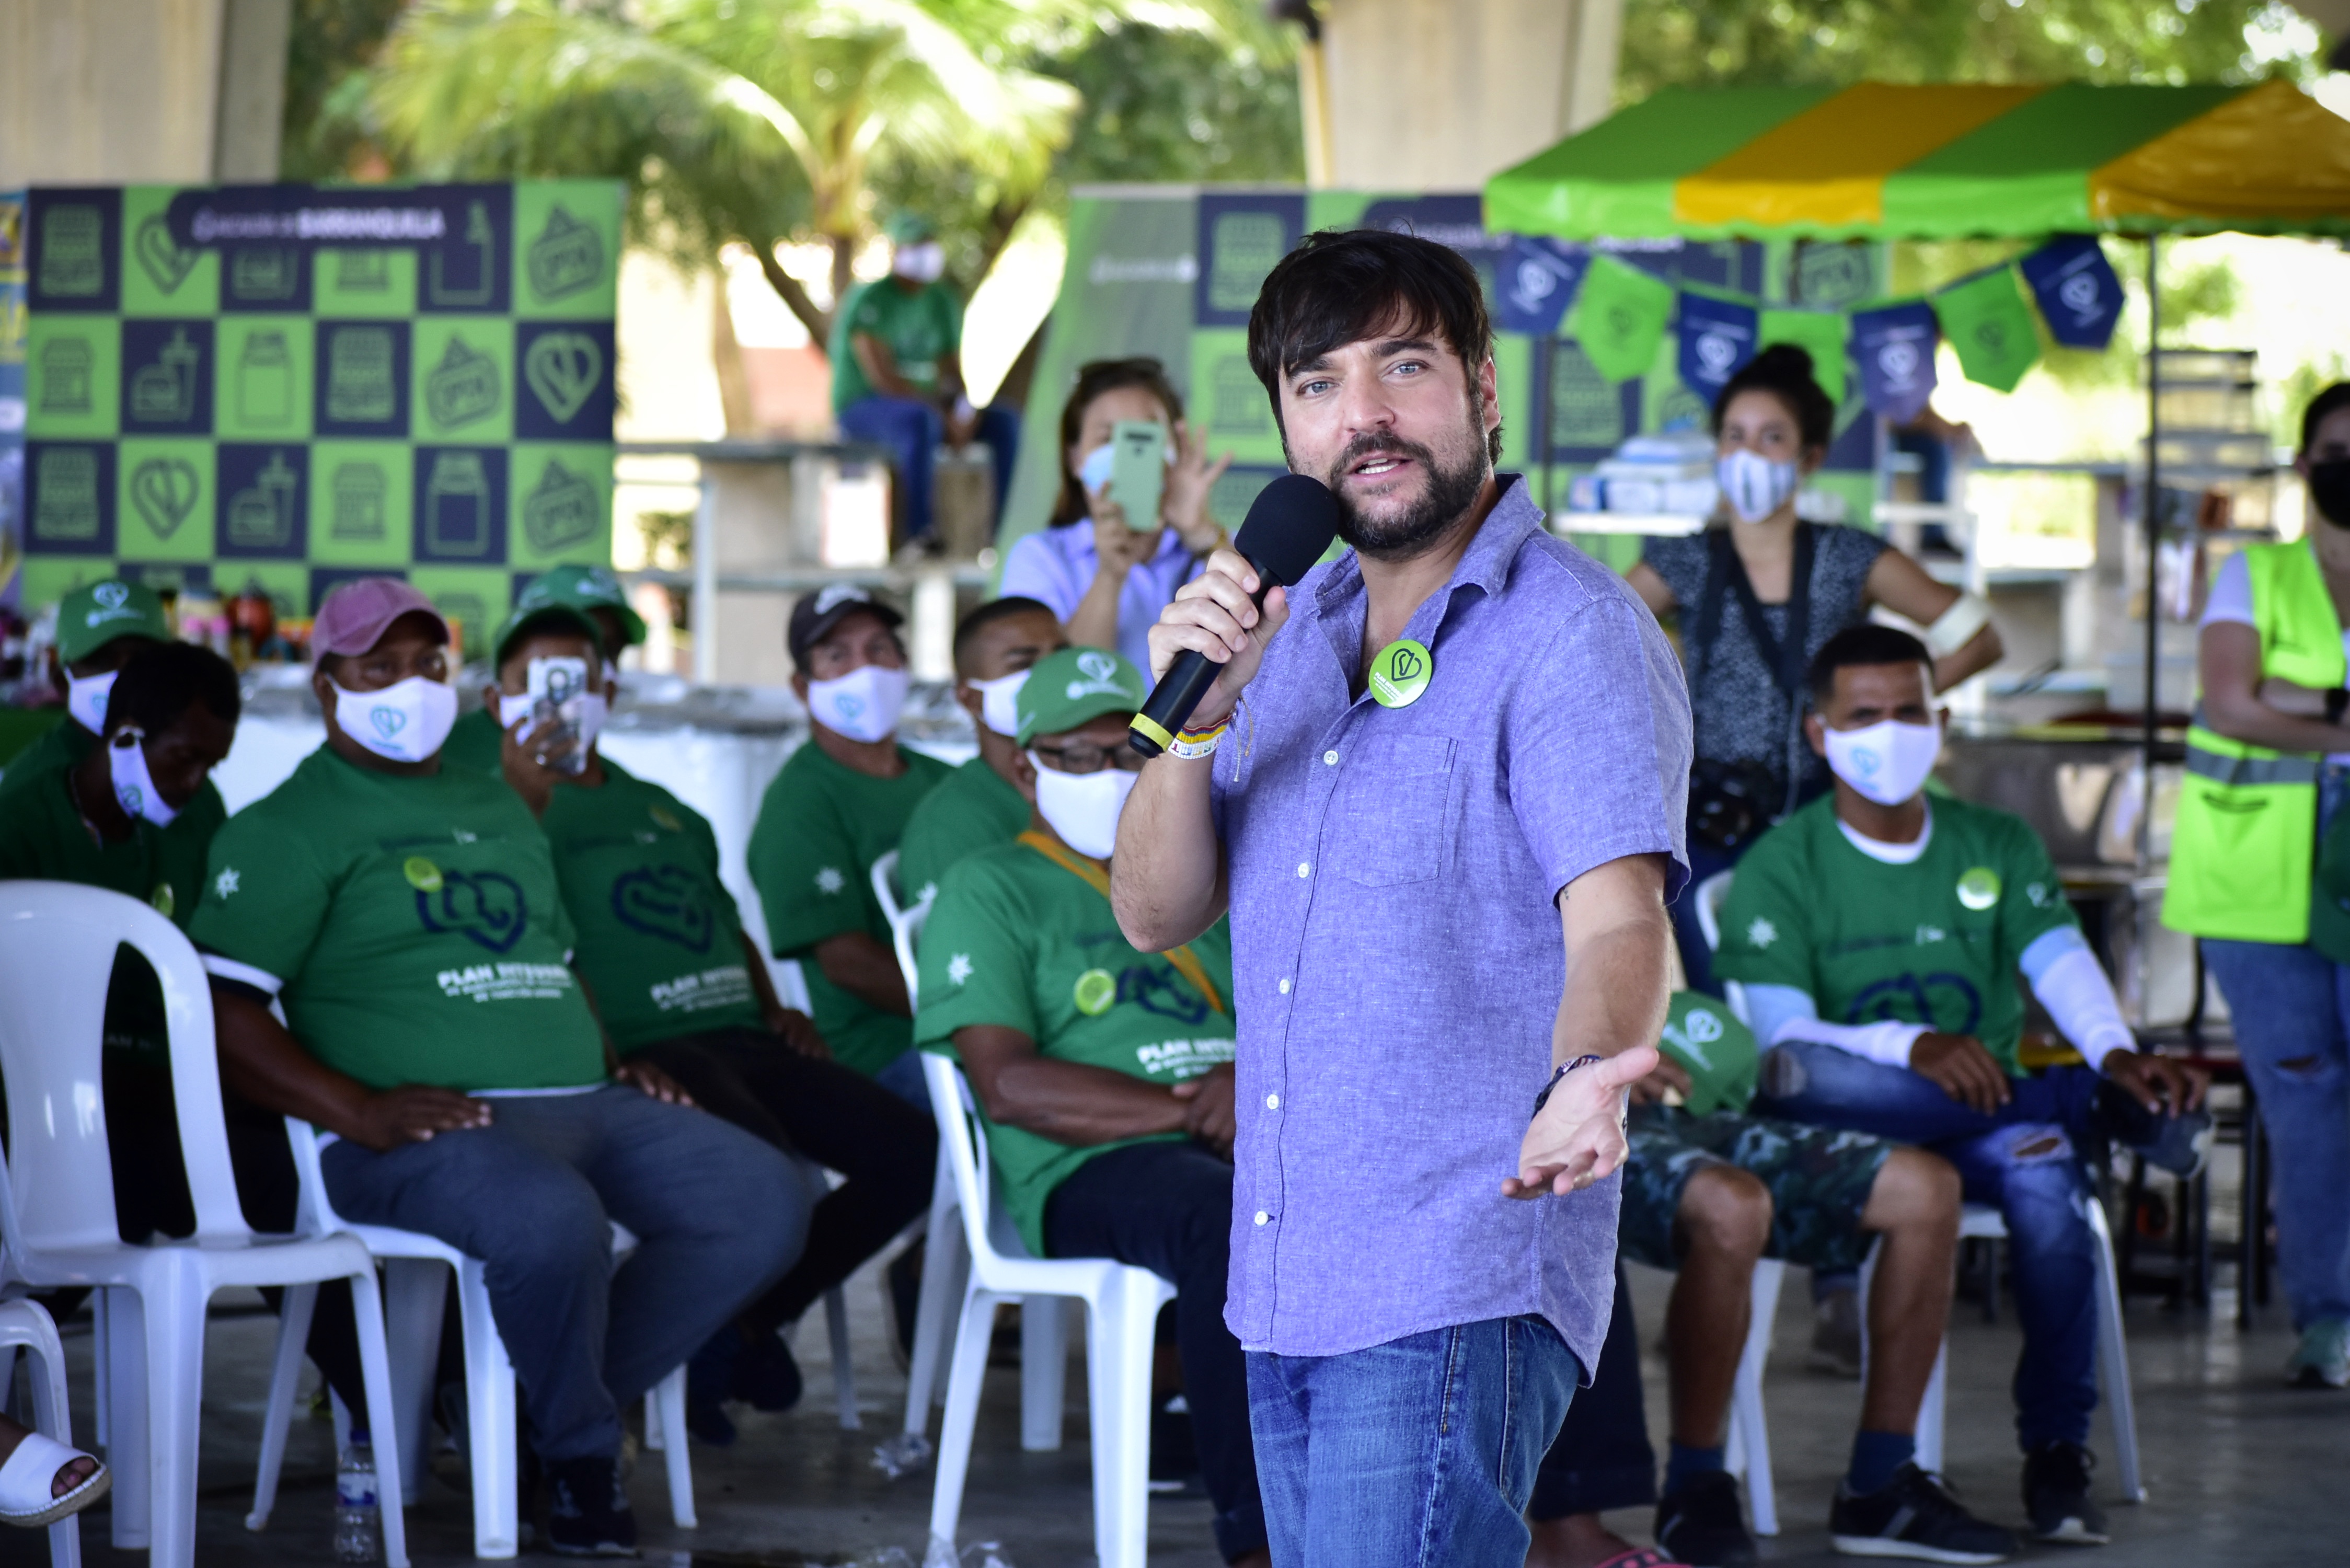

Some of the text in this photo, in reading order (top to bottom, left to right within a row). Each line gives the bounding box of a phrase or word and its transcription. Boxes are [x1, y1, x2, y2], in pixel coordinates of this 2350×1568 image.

[1375, 672, 1387, 684] PLAN
[436, 964, 493, 989] PLAN
[1136, 1040, 1192, 1064] PLAN
